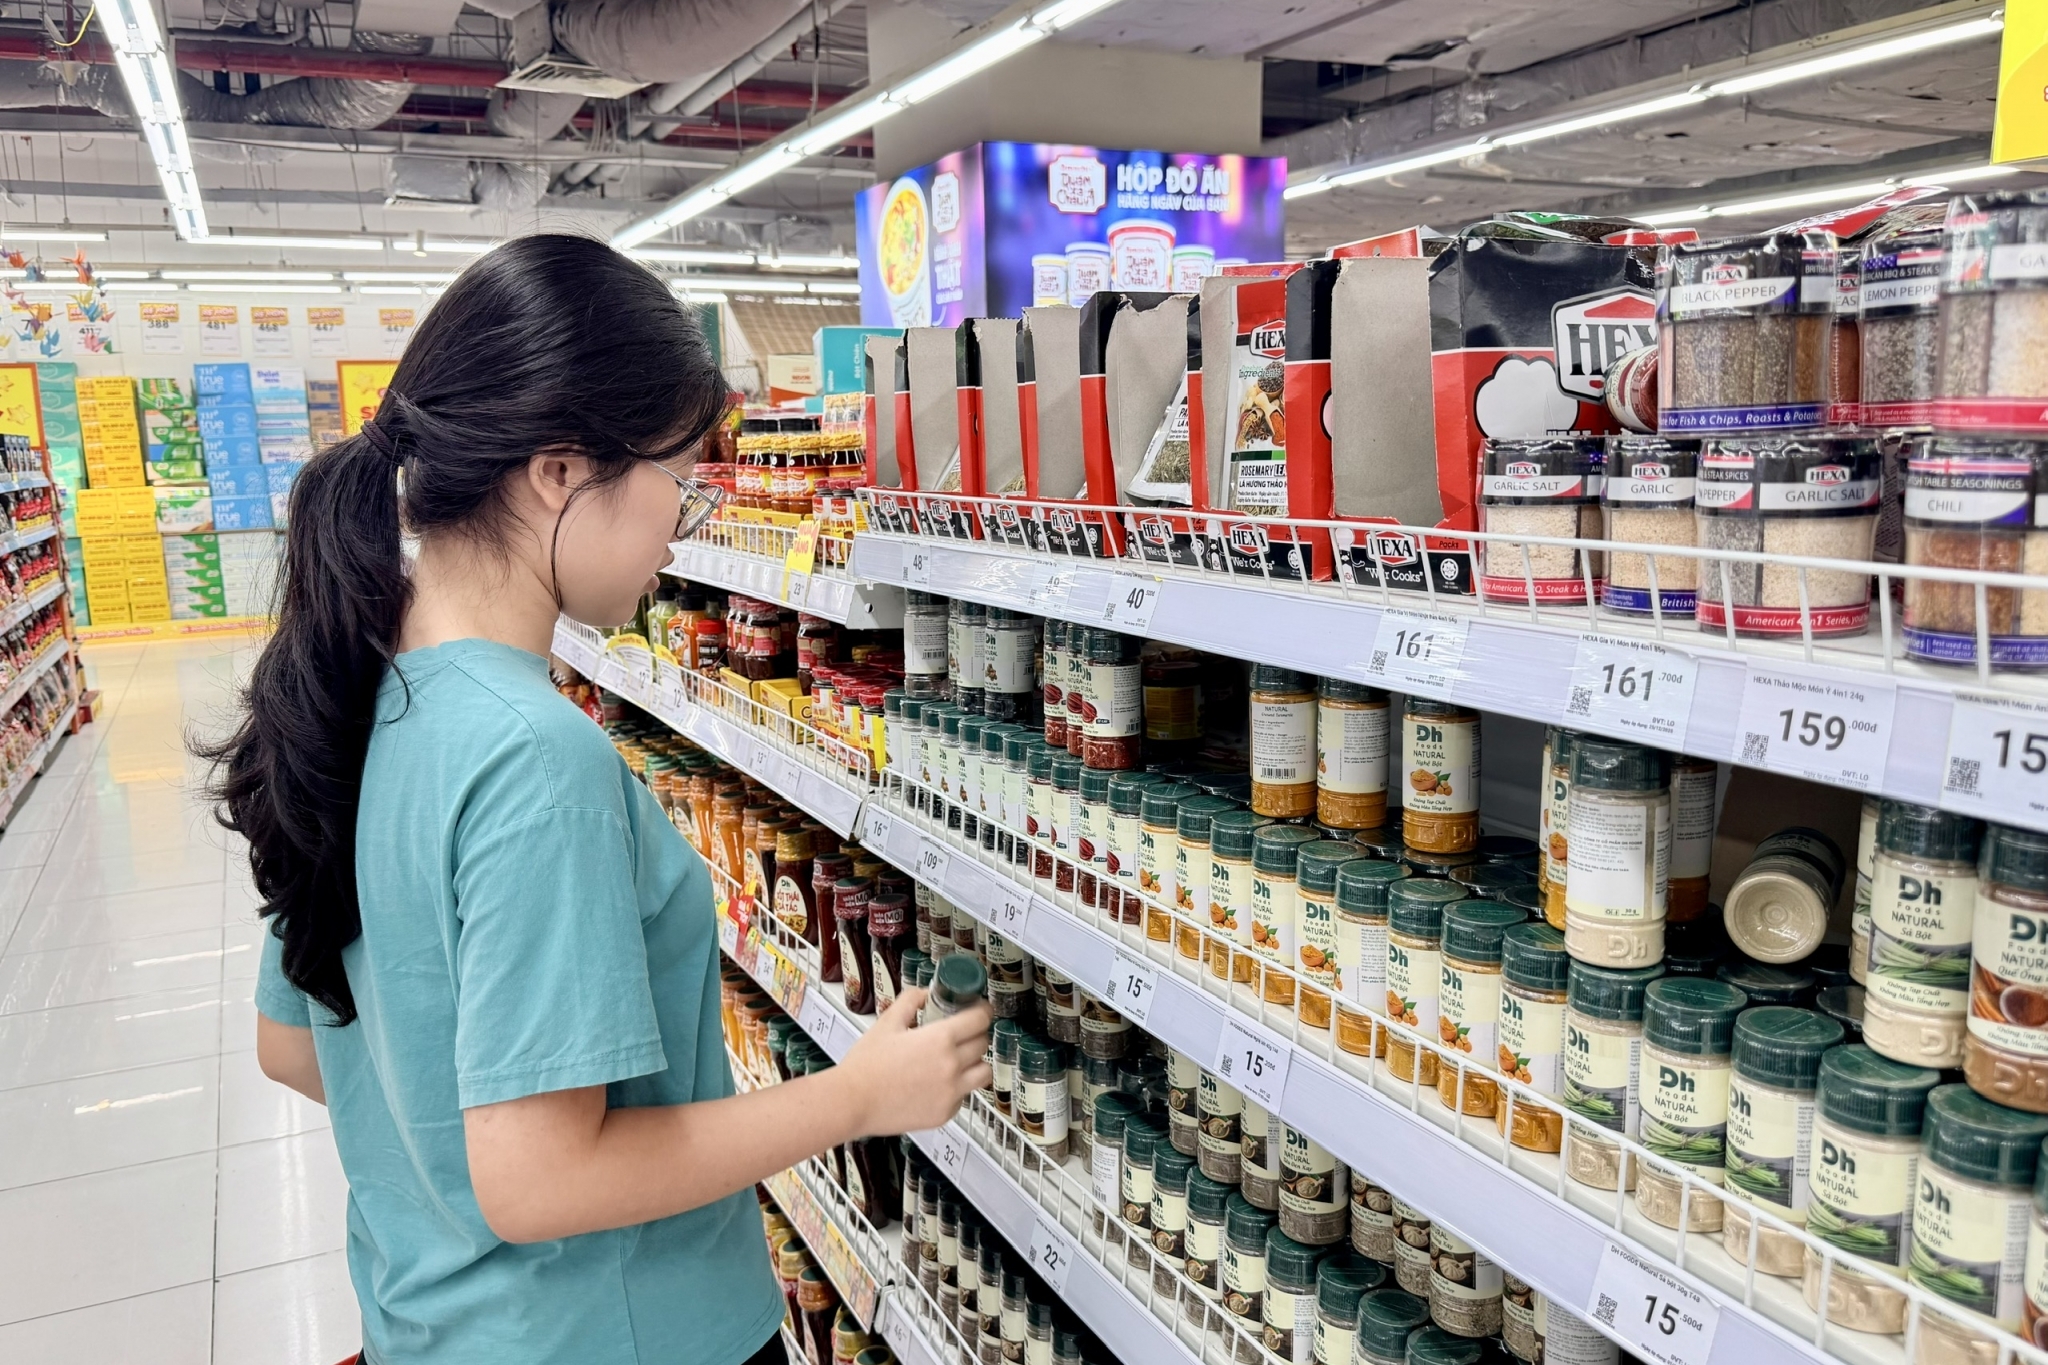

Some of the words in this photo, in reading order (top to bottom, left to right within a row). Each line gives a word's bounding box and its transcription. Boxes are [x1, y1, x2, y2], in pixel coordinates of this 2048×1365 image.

[1117, 161, 1163, 194] HỘP
[1165, 160, 1198, 194] ĐỒ
[1200, 164, 1230, 195] ĂN
[1705, 268, 1744, 281] HEXA
[1884, 269, 1898, 278] BBQ
[1899, 269, 1906, 277] &
[1907, 266, 1932, 276] STEAK
[1681, 288, 1723, 304] BLACK
[1725, 285, 1777, 301] PEPPER
[1864, 287, 1896, 302] LEMON
[1900, 284, 1938, 297] PEPPE
[200, 419, 224, 431] true
[1679, 415, 1697, 426] Fish
[1699, 415, 1706, 425] &
[1709, 415, 1742, 425] Chips,
[1746, 413, 1781, 424] Roasts
[1784, 411, 1790, 422] &
[1241, 464, 1274, 476] ROSEMARY
[1507, 464, 1539, 477] HEXA
[1634, 466, 1667, 479] HEXA
[1725, 471, 1749, 480] SPICES
[1810, 469, 1846, 483] HEXA
[1239, 480, 1245, 488] LÁ
[1246, 480, 1266, 488] HƯƠNG
[1267, 480, 1283, 488] THẢO
[1493, 480, 1531, 492] GARLIC
[1533, 480, 1560, 492] SALT
[1630, 483, 1674, 495] GARLIC
[1924, 477, 1947, 487] TABLE
[1950, 478, 2022, 490] SEASONINGS
[1704, 489, 1736, 501] PEPPER
[1785, 489, 1837, 504] GARLIC
[1840, 488, 1866, 501] SALT
[1927, 499, 1962, 512] CHILI
[1492, 584, 1522, 593] American
[1126, 588, 1145, 608] 40
[1661, 598, 1694, 609] British
[1745, 615, 1795, 627] American
[1825, 614, 1851, 626] Series,
[1396, 630, 1434, 661] 161
[1582, 634, 1598, 643] HEXA
[1600, 636, 1609, 644] Gia
[1610, 637, 1615, 646] Vị
[1617, 639, 1629, 647] Món
[1630, 640, 1639, 651] Mỹ
[1602, 663, 1654, 702] 161
[1658, 672, 1683, 684] .700đ
[1753, 675, 1772, 687] HEXA
[1773, 678, 1790, 689] Thảo
[1791, 680, 1807, 693] Mộc
[1808, 684, 1824, 694] Món
[1832, 687, 1848, 699] 4in1
[1850, 691, 1865, 703] 24g
[2011, 701, 2032, 711] Món
[1417, 725, 1442, 742] Dh
[1778, 707, 1847, 751] 159
[1848, 719, 1878, 734] .000đ
[1413, 750, 1445, 759] NATURAL
[873, 820, 882, 837] 16
[923, 850, 938, 870] 109
[1212, 863, 1229, 881] Dh
[1254, 879, 1271, 899] Dh
[1897, 874, 1942, 905] Dh
[1004, 902, 1015, 921] 19
[1305, 901, 1330, 922] Dh
[1897, 901, 1941, 916] Foods
[1891, 910, 1945, 931] NATURAL
[1302, 924, 1333, 938] NATURAL
[1900, 926, 1912, 938] Sả
[1915, 928, 1932, 941] Bột
[989, 935, 1003, 946] Dh
[1388, 945, 1408, 968] Dh
[1127, 975, 1143, 998] 15
[1441, 967, 1463, 991] Dh
[1501, 993, 1523, 1021] Dh
[1567, 1025, 1590, 1054] Dh
[1246, 1051, 1264, 1077] 15
[1201, 1073, 1217, 1093] Dh
[1659, 1065, 1696, 1093] Dh
[1658, 1087, 1696, 1103] Foods
[1729, 1083, 1751, 1117] Dh
[1654, 1094, 1699, 1115] NATURAL
[1661, 1110, 1673, 1121] Sả
[1674, 1113, 1689, 1123] Bột
[1286, 1128, 1308, 1150] Dh
[943, 1144, 956, 1167] 32
[1284, 1150, 1310, 1165] NATURAL
[1821, 1137, 1856, 1175] Dh
[1815, 1169, 1859, 1199] NATURAL
[1833, 1194, 1849, 1207] Bột
[1920, 1173, 1951, 1215] Dh
[1043, 1244, 1058, 1271] 22
[1611, 1245, 1620, 1255] DH
[1620, 1251, 1638, 1266] FOODS
[1639, 1262, 1658, 1278] Natural
[1659, 1274, 1666, 1282] Sả
[1666, 1279, 1676, 1289] bột
[1678, 1285, 1688, 1298] 30g
[1644, 1294, 1680, 1335] 15
[1680, 1314, 1702, 1332] .500đ
